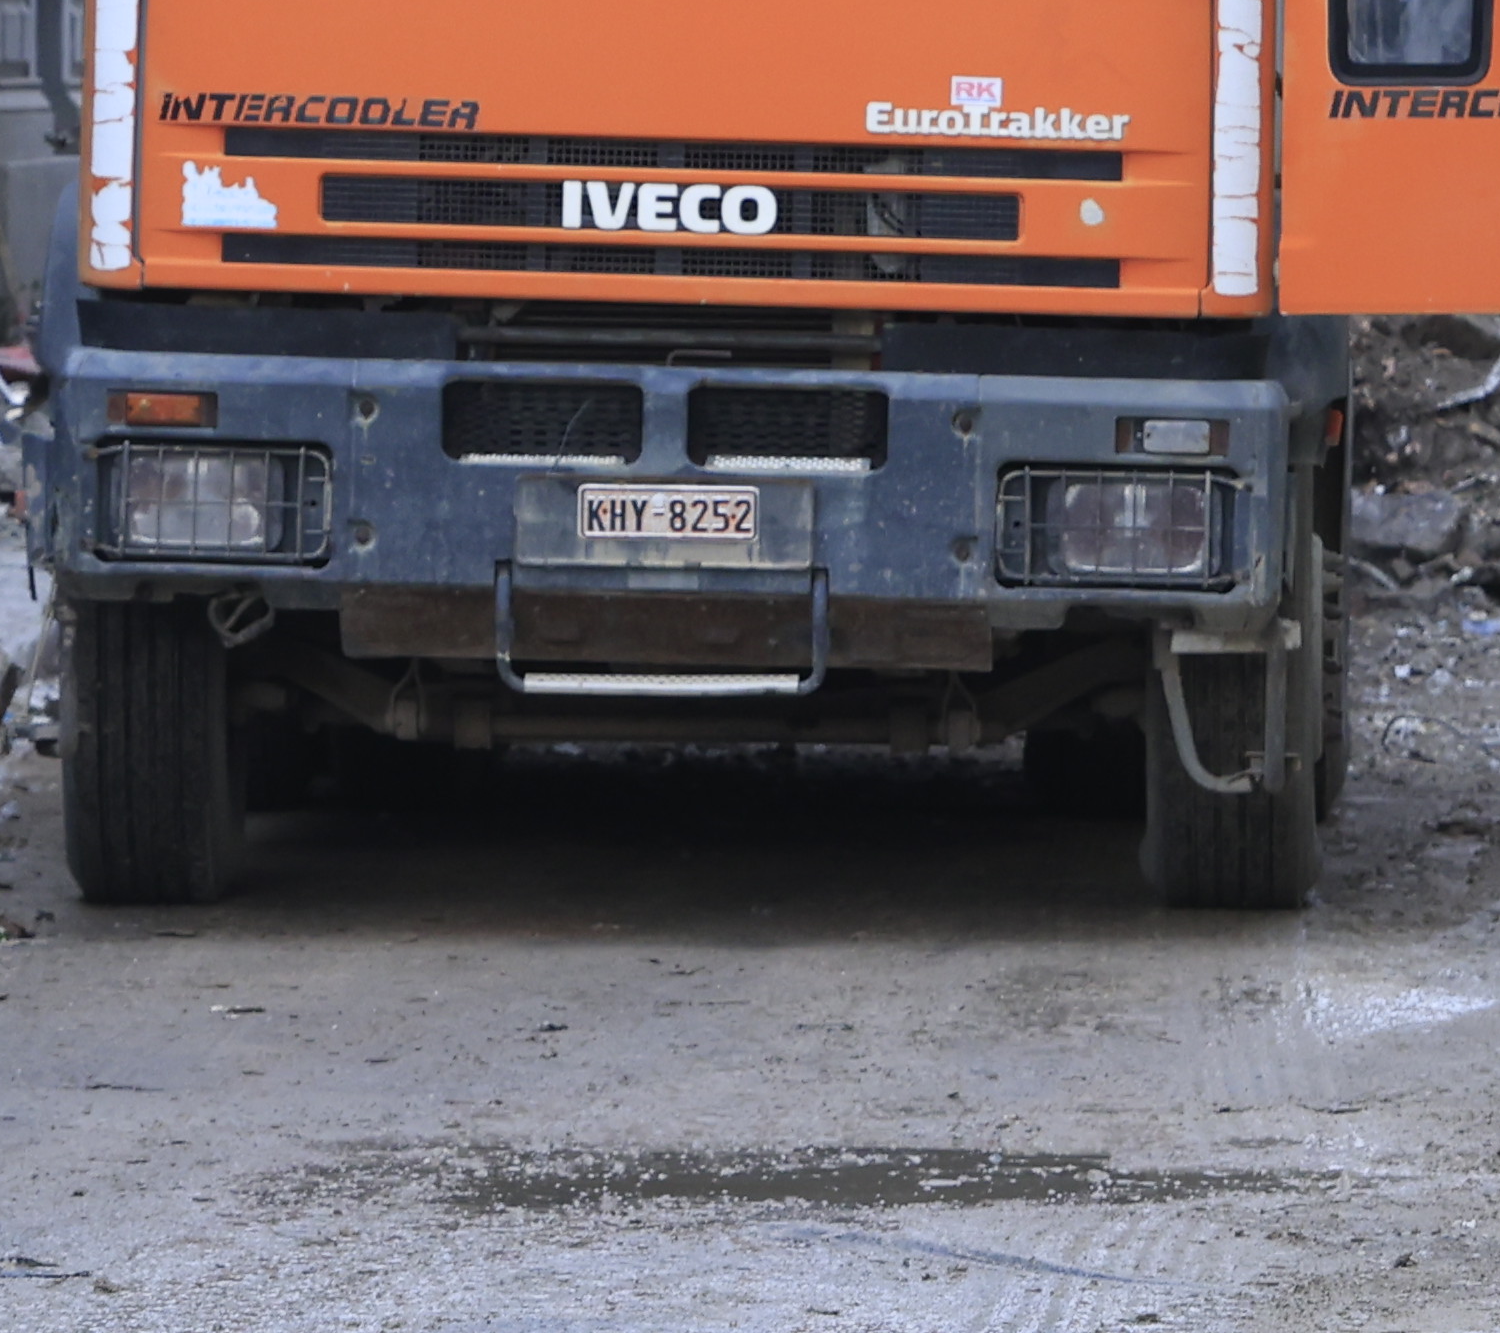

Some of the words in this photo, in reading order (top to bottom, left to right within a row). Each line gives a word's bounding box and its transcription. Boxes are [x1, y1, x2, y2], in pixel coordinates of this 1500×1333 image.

[158, 91, 481, 130] INTERCOOLER
[954, 82, 997, 100] RK
[865, 101, 1130, 140] EuroTrakker
[562, 180, 778, 235] IVECO
[587, 499, 753, 533] KHY-8252
